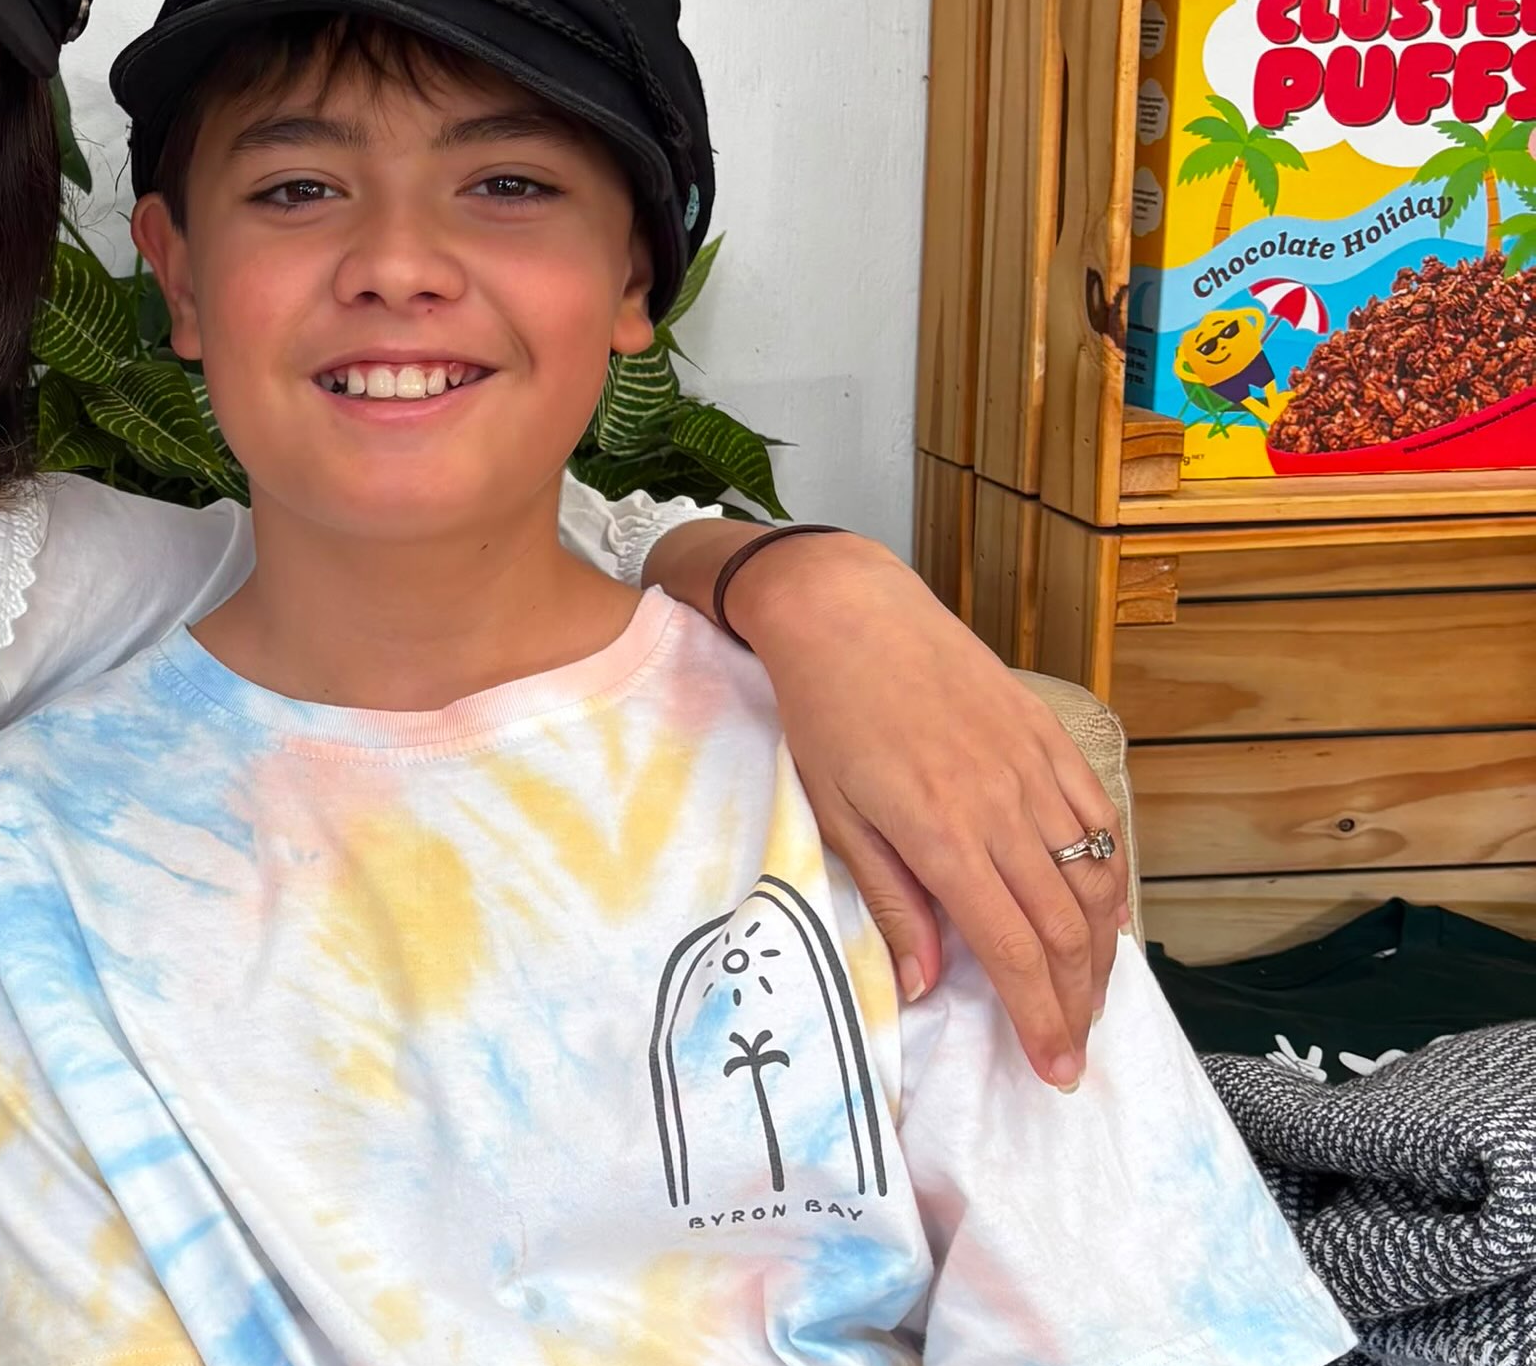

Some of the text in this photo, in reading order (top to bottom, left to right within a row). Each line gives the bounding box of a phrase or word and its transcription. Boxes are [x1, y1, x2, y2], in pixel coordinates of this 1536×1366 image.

[1193, 195, 1454, 298] Chocolate Holiday
[688, 1199, 863, 1228] BYRON BAY
